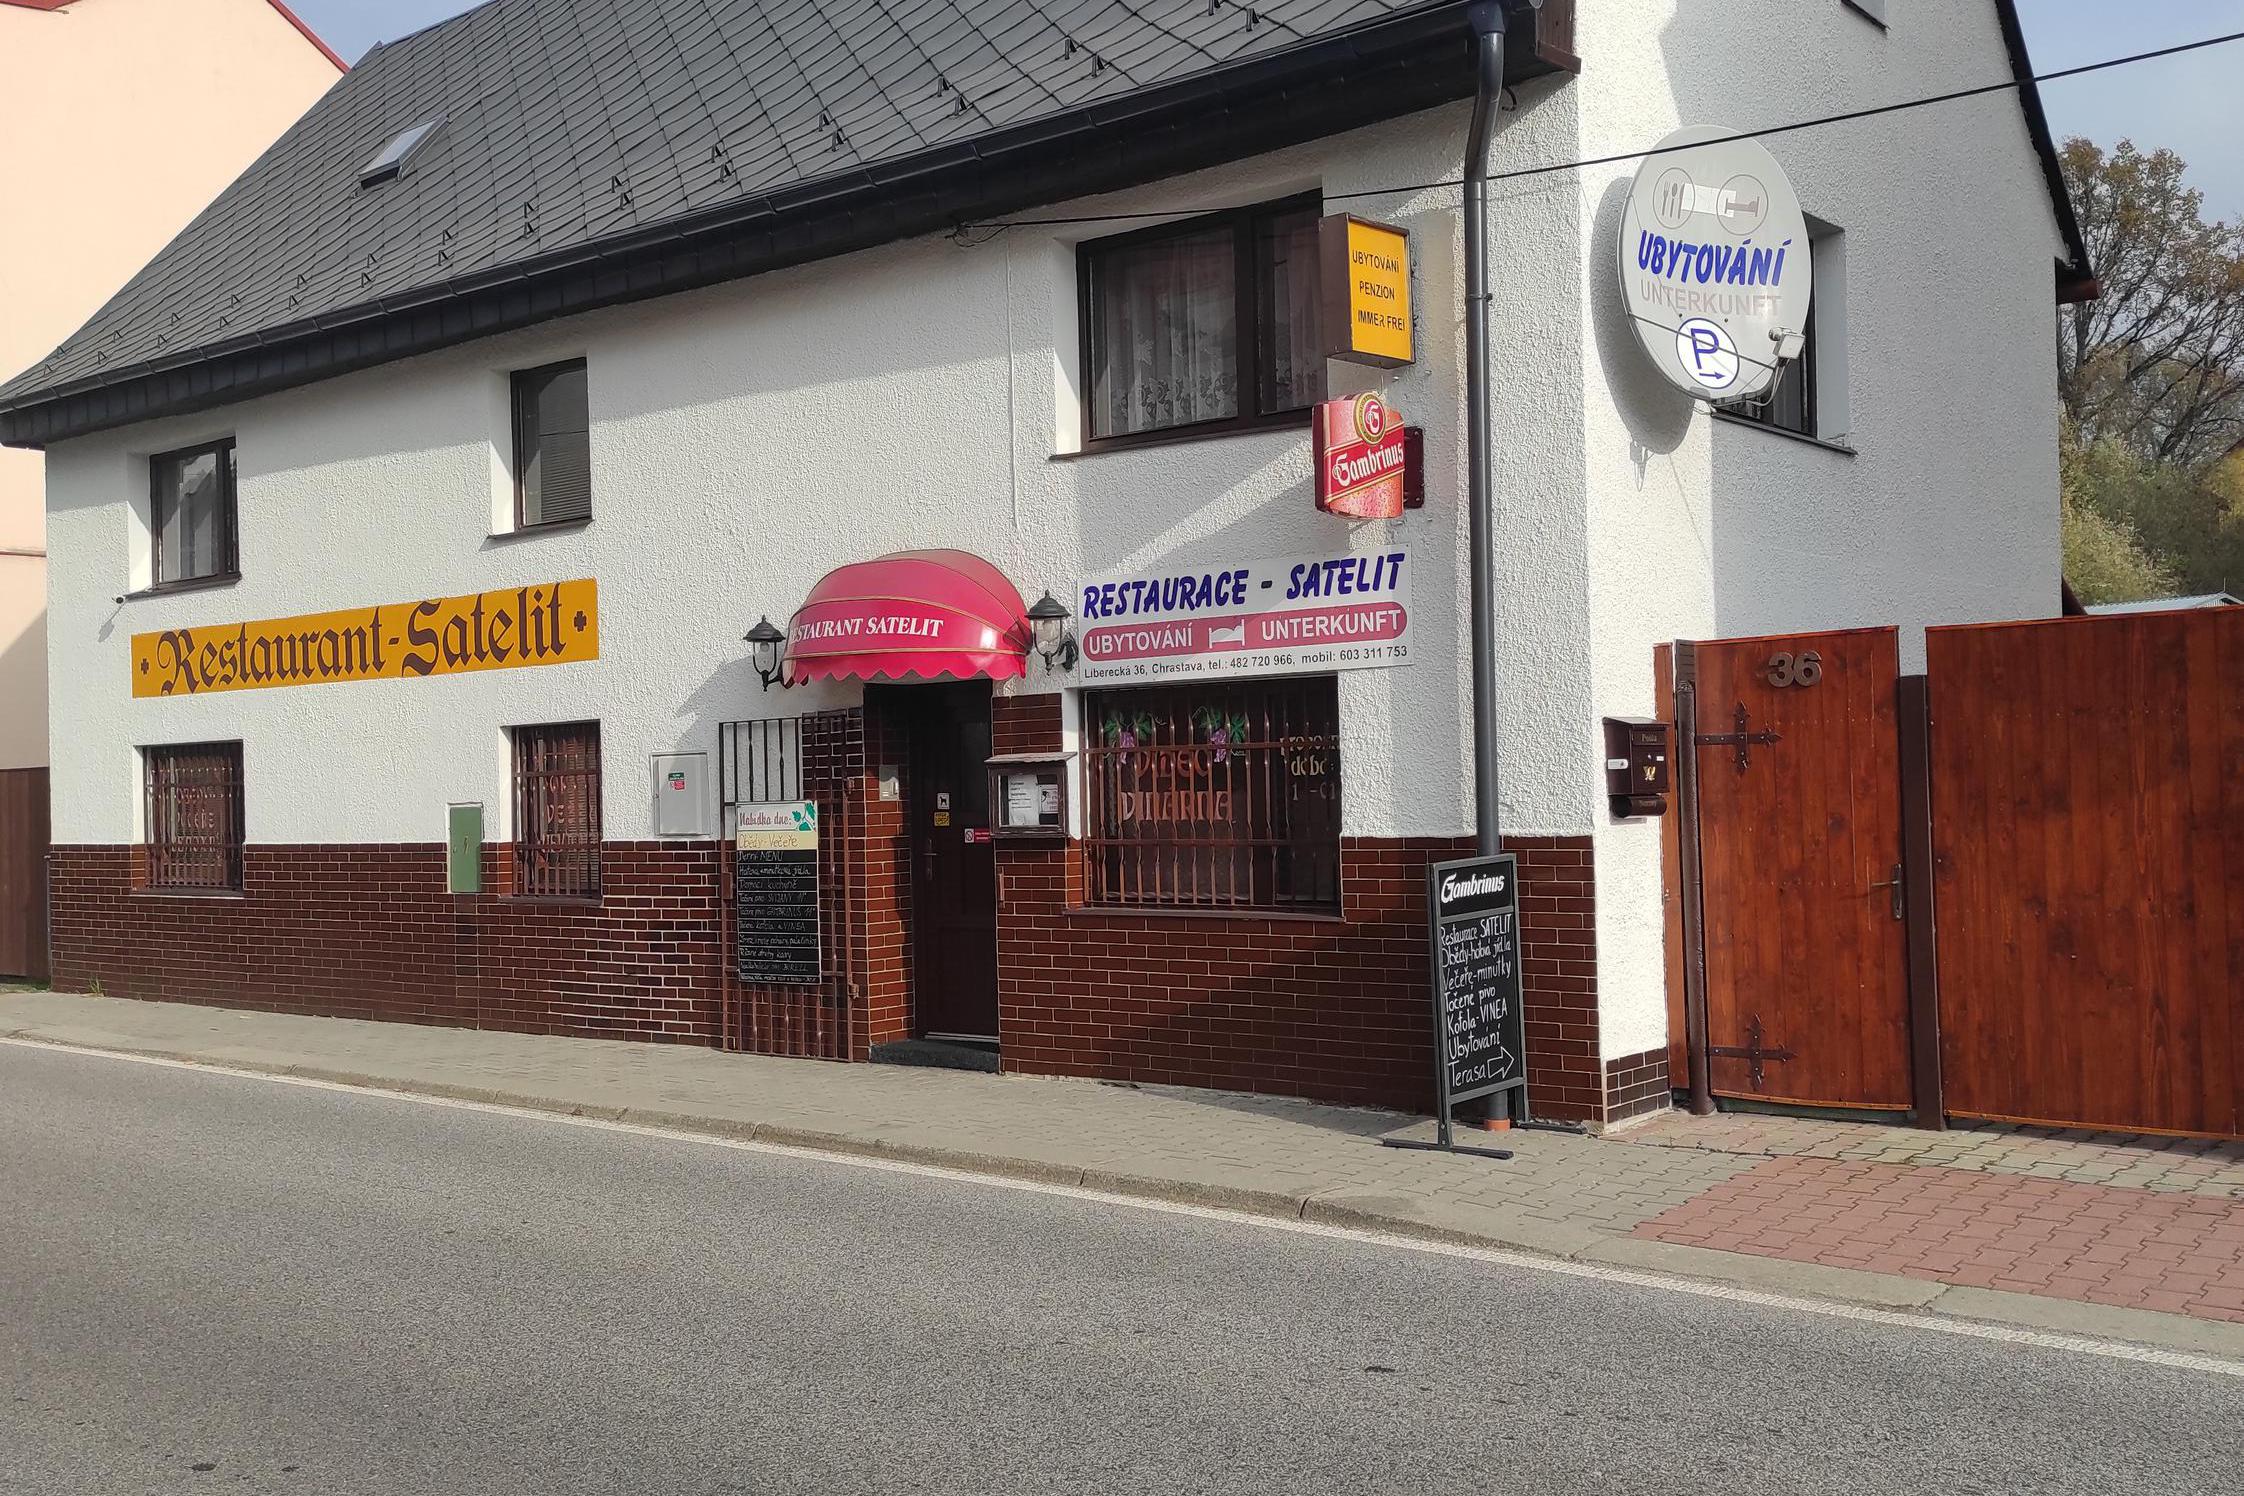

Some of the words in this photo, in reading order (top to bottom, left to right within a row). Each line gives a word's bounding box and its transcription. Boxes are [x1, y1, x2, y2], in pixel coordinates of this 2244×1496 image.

[1352, 249, 1399, 273] UBYTOVÁNÍ
[1638, 229, 1792, 286] UBYTOVÁNÍ
[1359, 281, 1395, 301] PENZION
[1641, 279, 1782, 316] UNTERKUNFT
[1358, 309, 1386, 329] IMMER
[1387, 315, 1405, 332] FREI
[1690, 328, 1719, 370] P
[1332, 442, 1404, 487] Gambrinus
[1083, 569, 1249, 620] RESTAURACE
[1286, 553, 1405, 600] SATELIT
[866, 616, 944, 638] SATELIT
[1089, 622, 1192, 655] UBYTOVÁNÍ
[1262, 609, 1401, 641] UNTERKUNFT
[1084, 665, 1131, 679] Liberecká
[1134, 664, 1148, 677] 36,
[1151, 661, 1206, 675] Chrastava,
[1230, 657, 1249, 669] 482
[1251, 655, 1270, 667] 720
[1274, 652, 1296, 666] 966,
[1301, 650, 1336, 664] mobil:
[1339, 648, 1360, 661] 603
[1363, 647, 1382, 660] 311
[1386, 644, 1408, 658] 753
[1767, 651, 1822, 688] 36
[1440, 872, 1505, 904] Gambrinus
[1440, 923, 1479, 947] Restaurace
[1479, 913, 1512, 938] SATELIT
[1444, 984, 1475, 1013] Točené
[1478, 984, 1496, 1006] pivo
[1448, 1022, 1501, 1060] Ubytování
[1446, 1059, 1487, 1087] Terasa
